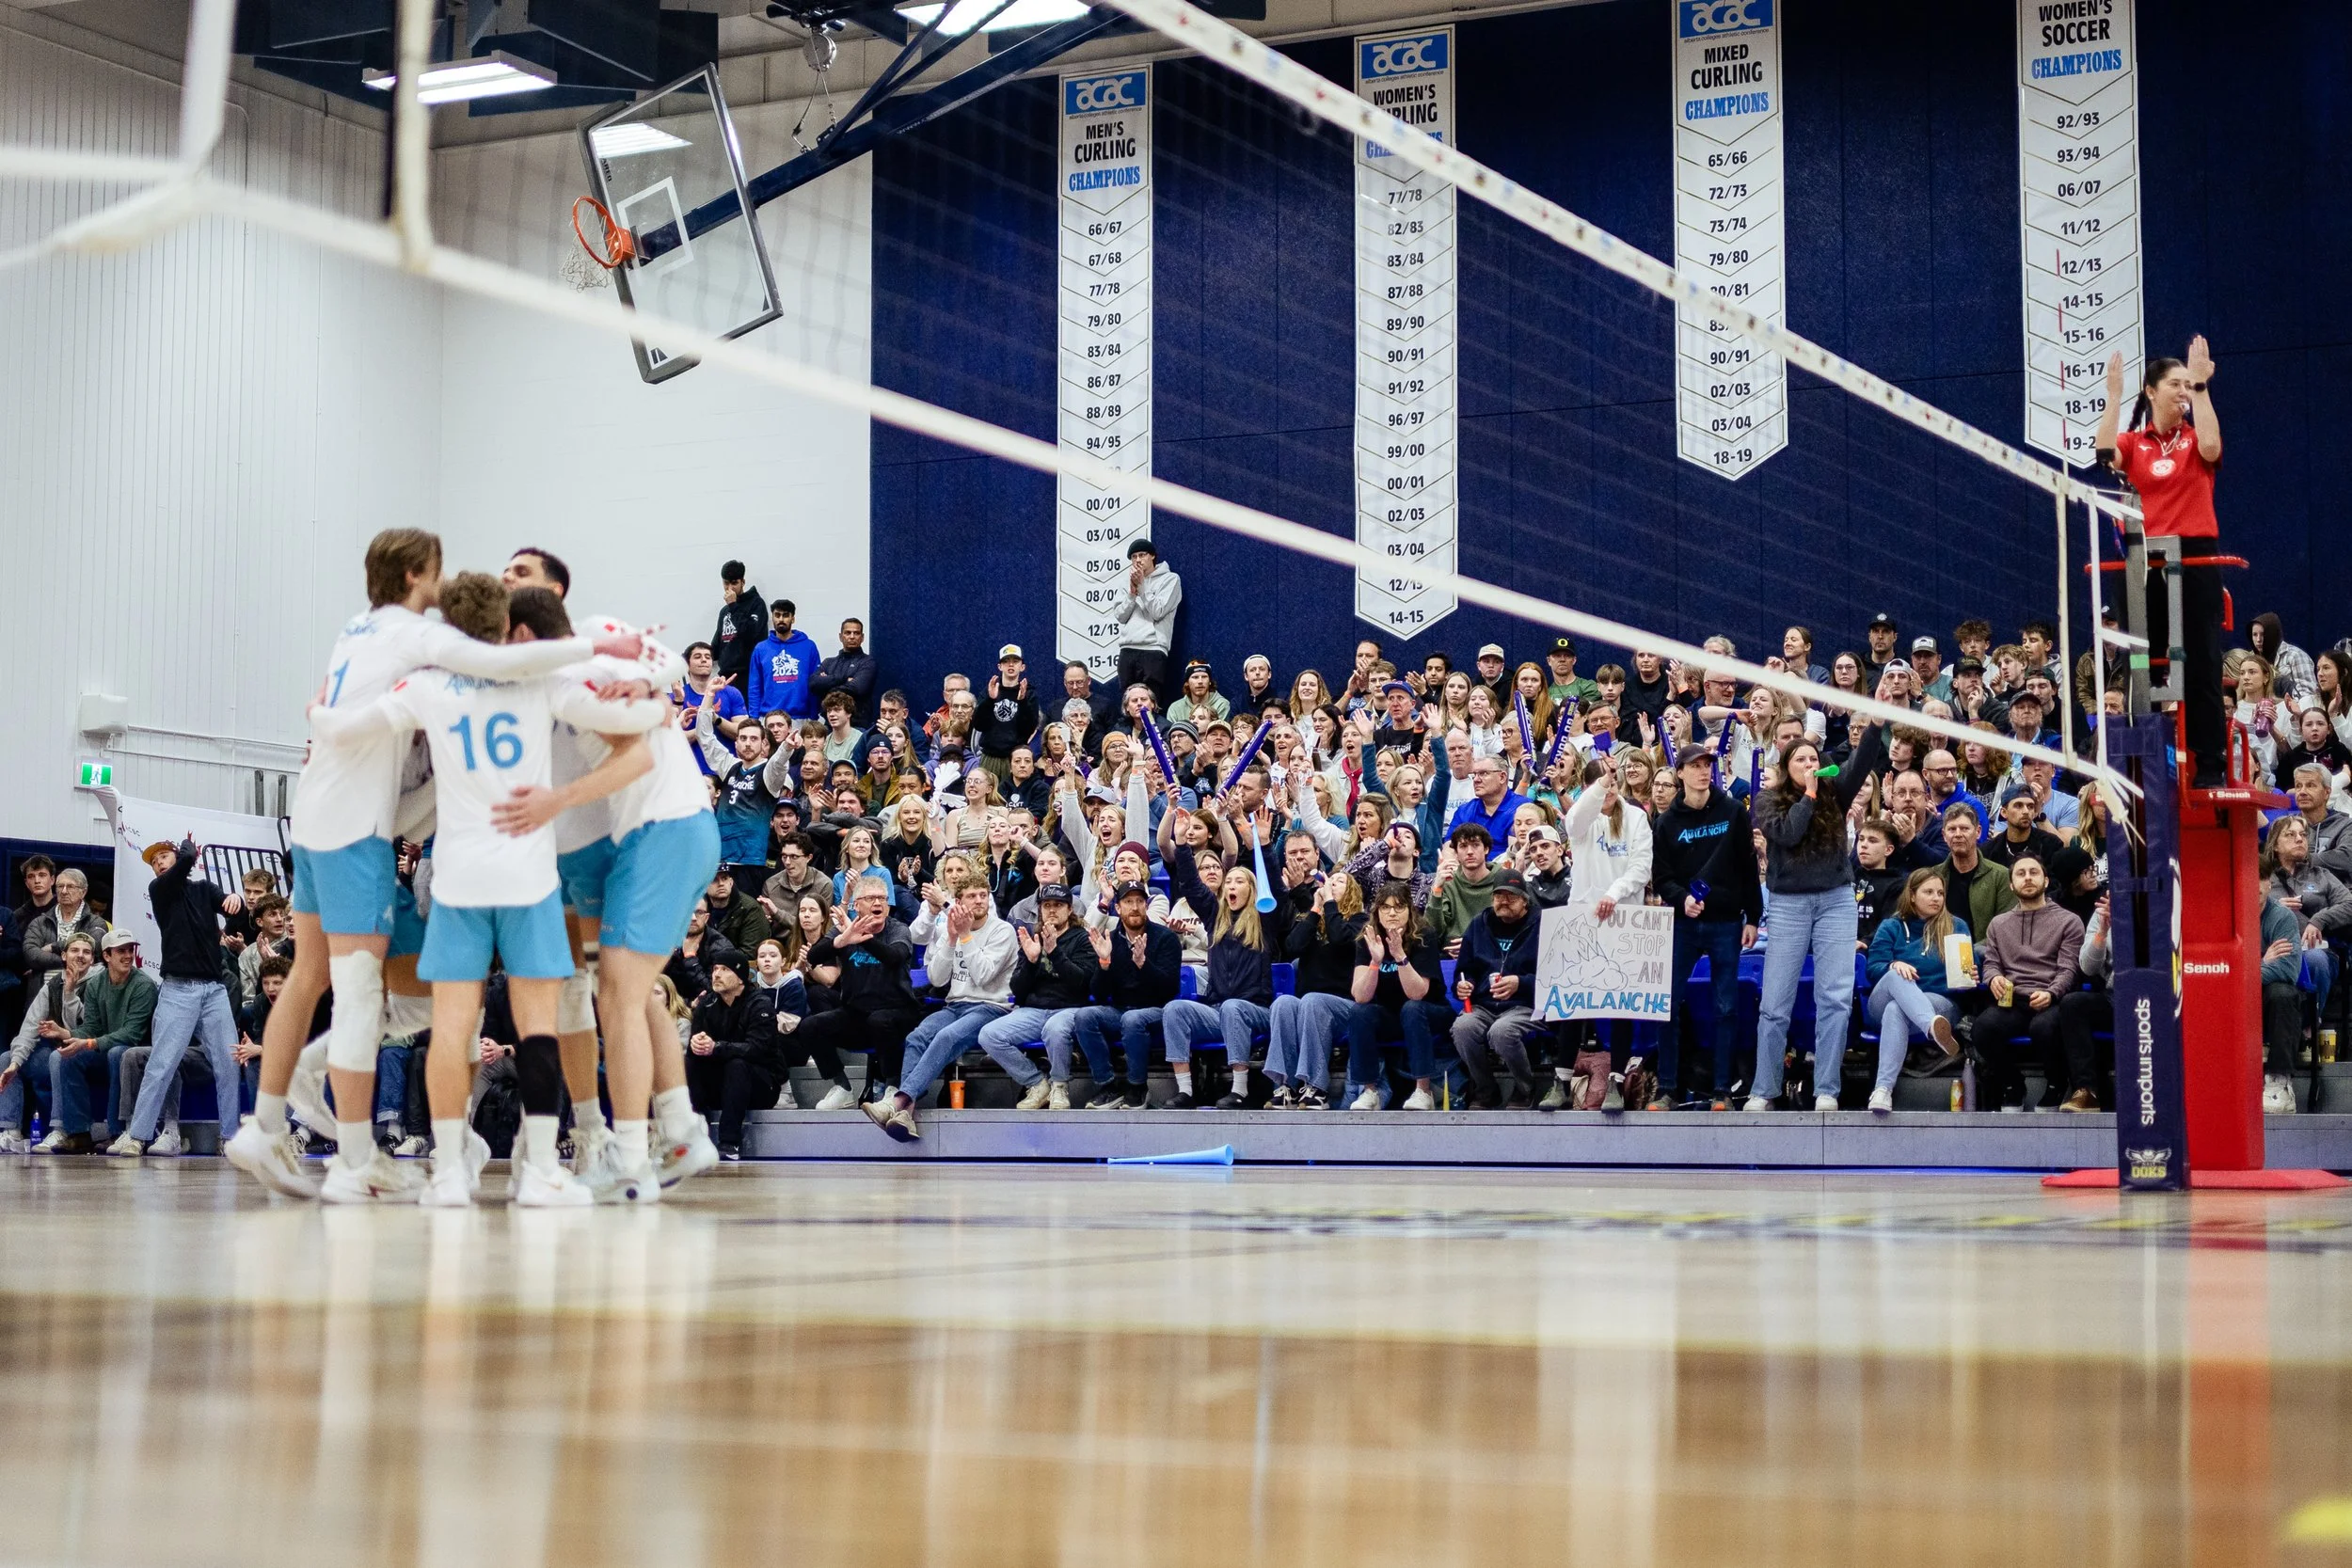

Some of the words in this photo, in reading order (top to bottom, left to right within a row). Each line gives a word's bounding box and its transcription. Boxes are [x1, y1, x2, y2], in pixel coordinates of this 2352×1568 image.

[2039, 0, 2112, 22] WOMEN'S
[2042, 19, 2110, 47] SOCCER
[1373, 39, 1436, 73] acac
[1705, 43, 1749, 64] MIXED
[2031, 49, 2122, 79] CHAMPIONS
[1691, 61, 1763, 89] CURLING
[1076, 77, 1134, 110] acac
[1374, 84, 1436, 105] WOMEN'S
[1382, 102, 1438, 125] RLING
[1685, 91, 1769, 120] CHAMPIONS
[2057, 112, 2100, 129] 92/93
[1086, 121, 1123, 139] MEN'S
[1074, 138, 1136, 164] CURLING
[1708, 151, 1748, 167] 65/66
[2057, 146, 2100, 163] 93/94
[1069, 166, 1140, 192] CHAMPIONS
[1389, 188, 1422, 204] 77/78
[1708, 184, 1747, 200] 72/73
[2058, 181, 2101, 197] 06/07
[1089, 221, 1121, 236] 66/67
[1388, 220, 1423, 235] 82/83
[1709, 217, 1747, 233] 73/74
[2061, 219, 2100, 234] 11/12
[1089, 251, 1121, 266] 67/68
[1387, 252, 1423, 267] 83/84
[1709, 250, 1748, 266] 79/80
[2061, 258, 2102, 275] 12/13
[1089, 282, 1120, 297] 77/78
[1388, 284, 1422, 299] 87/88
[2062, 293, 2103, 309] 14-15
[1088, 312, 1121, 327] 79/80
[1387, 315, 1424, 330] 89/90
[2064, 327, 2104, 343] 15-16
[1088, 343, 1120, 358] 83/84
[1388, 348, 1424, 363] 90/91
[1710, 350, 1750, 364] 90/91
[2064, 362, 2105, 378] 16-17
[1088, 373, 1120, 388] 86/87
[1389, 380, 1423, 394] 91/92
[1710, 383, 1750, 398] 02/03
[1087, 404, 1121, 420] 88/89
[2065, 398, 2106, 414] 18-19
[1389, 411, 1424, 426] 96/97
[1712, 416, 1752, 431] 03/04
[1087, 436, 1120, 450] 94/95
[1388, 443, 1424, 458] 99/00
[2065, 436, 2096, 450] 19-2
[1713, 449, 1752, 464] 18-19
[1388, 475, 1424, 490] 00/01
[1087, 496, 1120, 511] 00/01
[1388, 508, 1424, 522] 02/03
[1087, 528, 1120, 542] 03/04
[1388, 543, 1424, 556] 03/04
[1087, 558, 1120, 573] 05/06
[1389, 610, 1423, 624] 14-15
[1088, 623, 1120, 637] 12/13
[1088, 655, 1119, 668] 15-16
[771, 668, 798, 677] 2025
[448, 711, 523, 771] 16
[728, 790, 739, 804] 3
[1631, 910, 1673, 931] CAN'T
[1617, 933, 1665, 957] STOP
[1638, 961, 1663, 984] AN
[2184, 962, 2230, 974] Senoh
[1544, 986, 1671, 1019] AVALANCHE
[2134, 998, 2154, 1054] sports
[2137, 1057, 2156, 1126] imports
